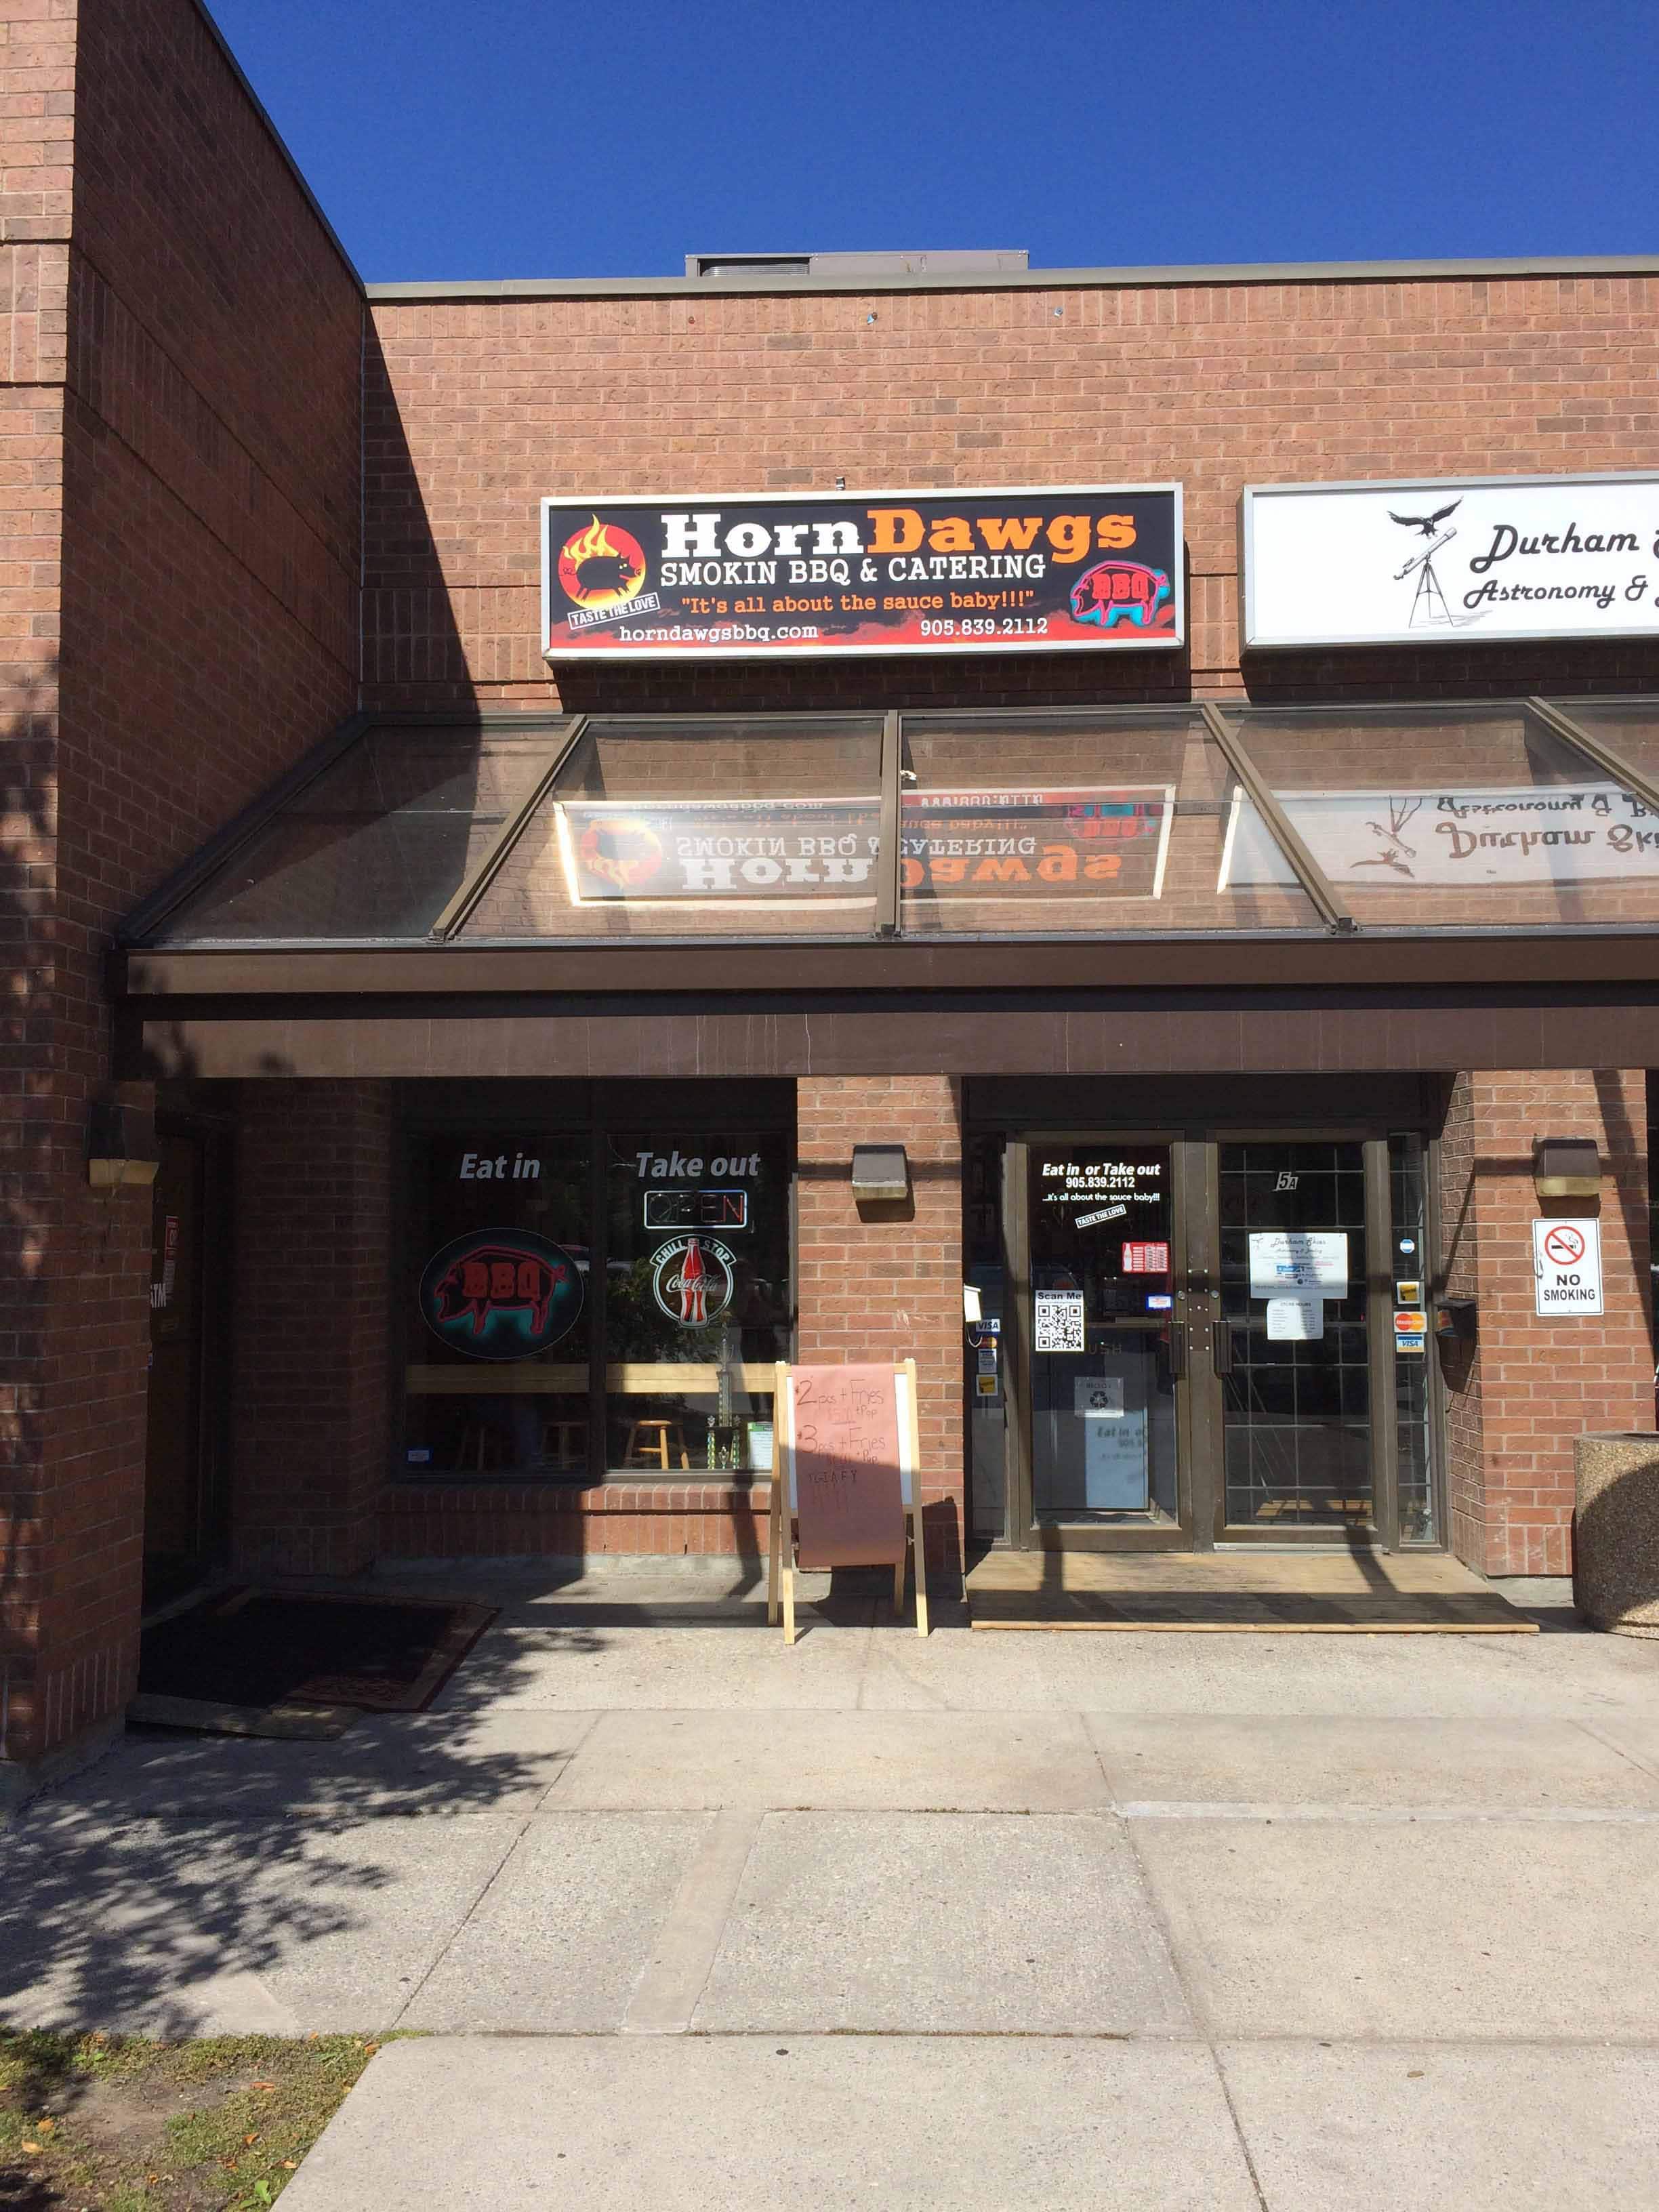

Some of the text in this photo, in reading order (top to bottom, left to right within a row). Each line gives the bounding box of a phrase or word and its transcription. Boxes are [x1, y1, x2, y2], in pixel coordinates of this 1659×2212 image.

[661, 508, 1137, 563] Horn Dawgs
[1469, 522, 1640, 573] Durham
[661, 554, 1046, 586] SMOKIN BBQ & CATERING
[1091, 573, 1150, 600] BBQ
[1462, 575, 1649, 609] Astronomy &
[571, 596, 657, 625] TASTE THE LOVE
[682, 590, 1035, 614] "It's all about the sauce baby!!!"
[619, 625, 819, 643] horndawgsbbq.com
[920, 617, 1048, 636] 905.839.2112
[459, 1151, 761, 1179] Eat in Take out
[1042, 1162, 1161, 1176] Eat in or Take out
[1065, 1176, 1136, 1188] 905.839.2112
[649, 1193, 743, 1223] OPEN
[1059, 1192, 1069, 1202] all
[1070, 1192, 1094, 1202] about
[1094, 1192, 1108, 1202] the
[1134, 1192, 1160, 1204] baby!!!
[1078, 1206, 1124, 1226] TASTE THE LOVE
[655, 1239, 731, 1265] CHILL STOP
[462, 1262, 543, 1300] BBQ
[1556, 1274, 1581, 1286] NO
[1038, 1292, 1082, 1300] Scan Me
[1543, 1289, 1595, 1301] SMOKING
[978, 1322, 998, 1330] VISA
[850, 1378, 884, 1405] Fries
[848, 1427, 886, 1451] Fries
